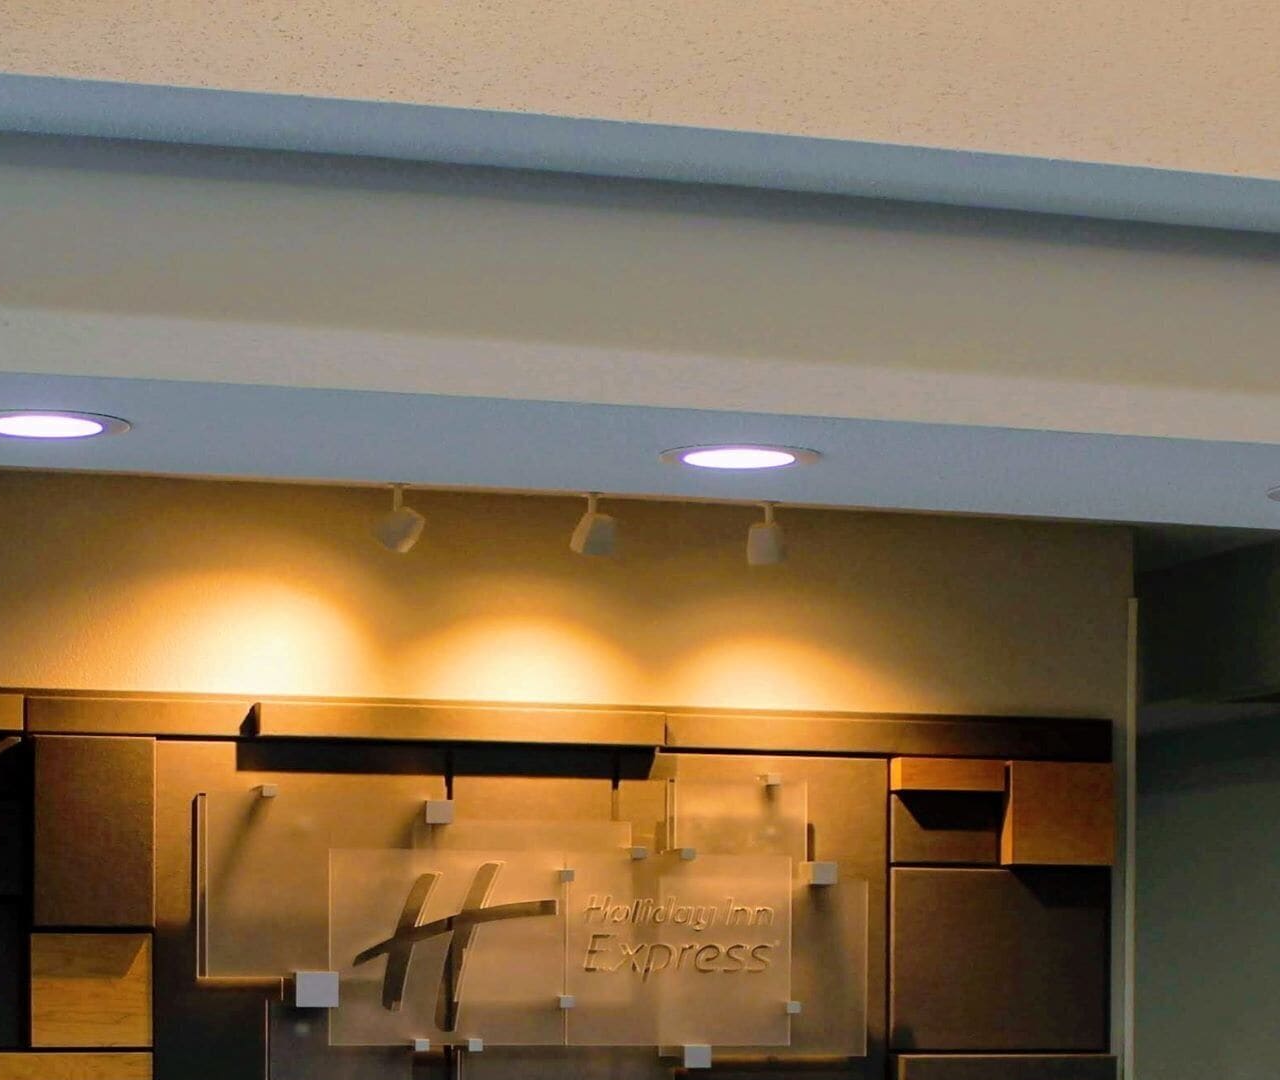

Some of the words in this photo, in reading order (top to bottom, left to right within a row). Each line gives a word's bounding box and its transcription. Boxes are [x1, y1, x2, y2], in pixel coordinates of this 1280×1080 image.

[584, 895, 717, 931] Holiday
[726, 896, 775, 926] Inn
[584, 933, 773, 983] Express
